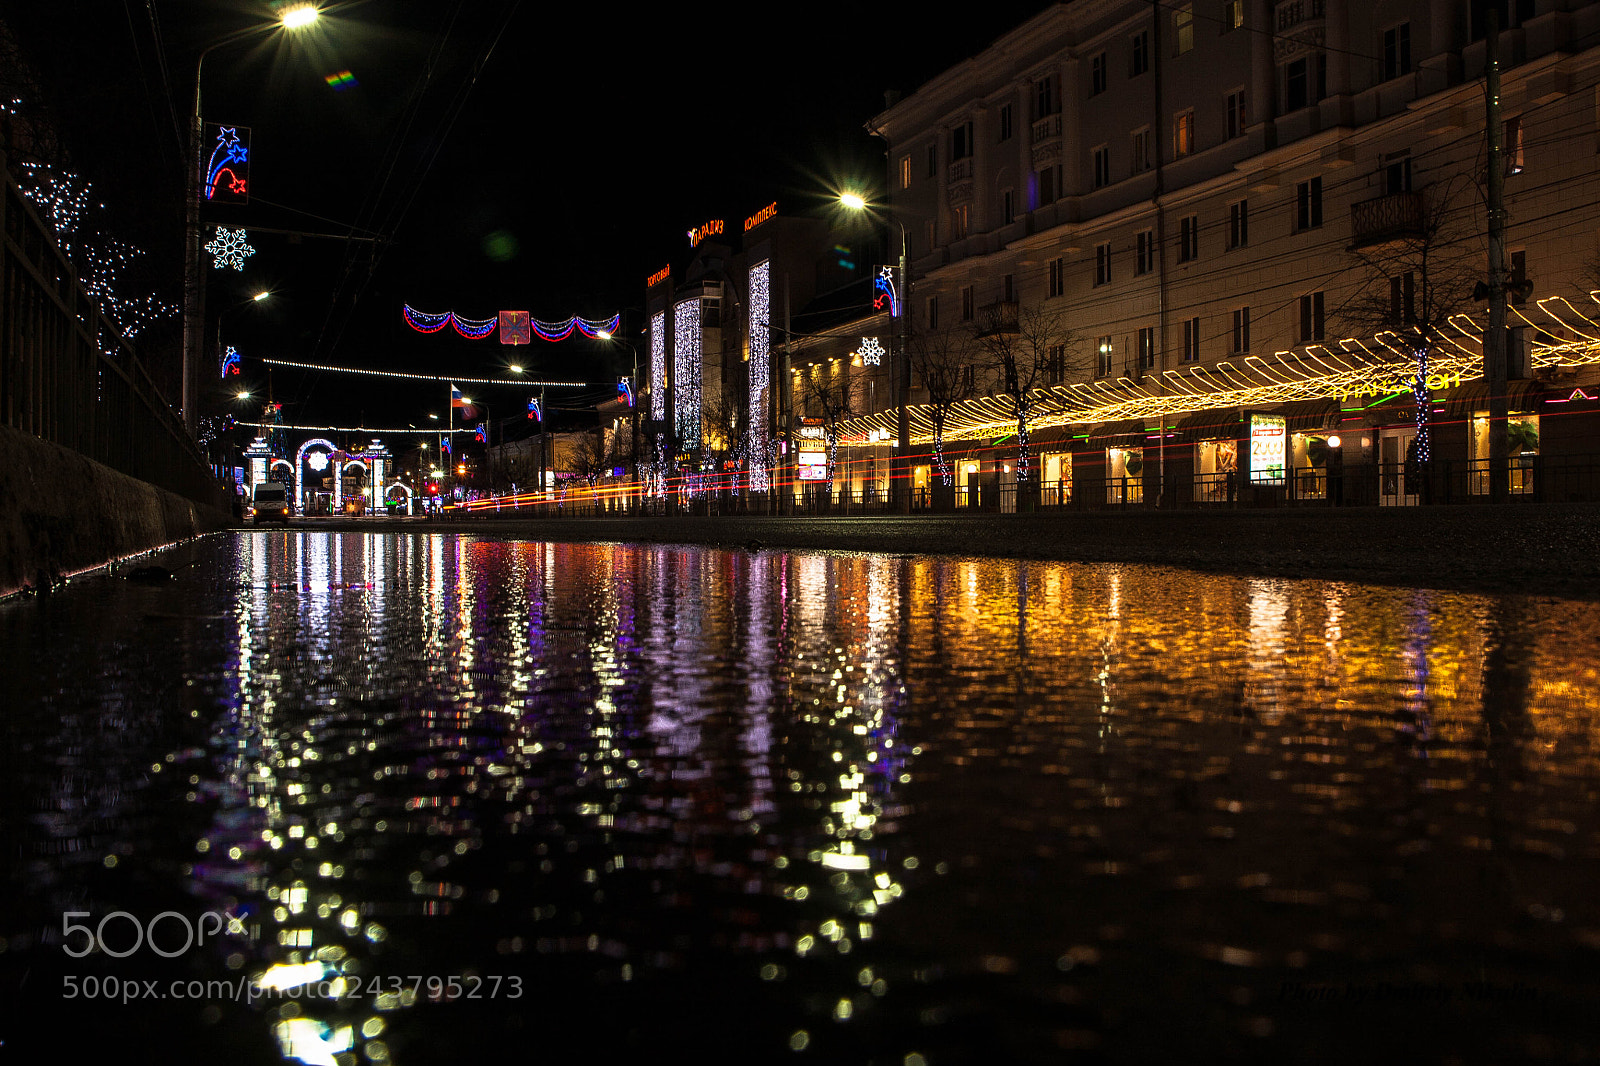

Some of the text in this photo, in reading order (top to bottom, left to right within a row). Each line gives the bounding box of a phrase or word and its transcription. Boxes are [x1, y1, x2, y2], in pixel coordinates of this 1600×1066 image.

[744, 201, 778, 232] КОМПЛЕКС
[693, 219, 725, 248] ПАРАДИЗ
[647, 263, 671, 288] ТОРГОВЫЙ
[1251, 440, 1284, 456] 2000
